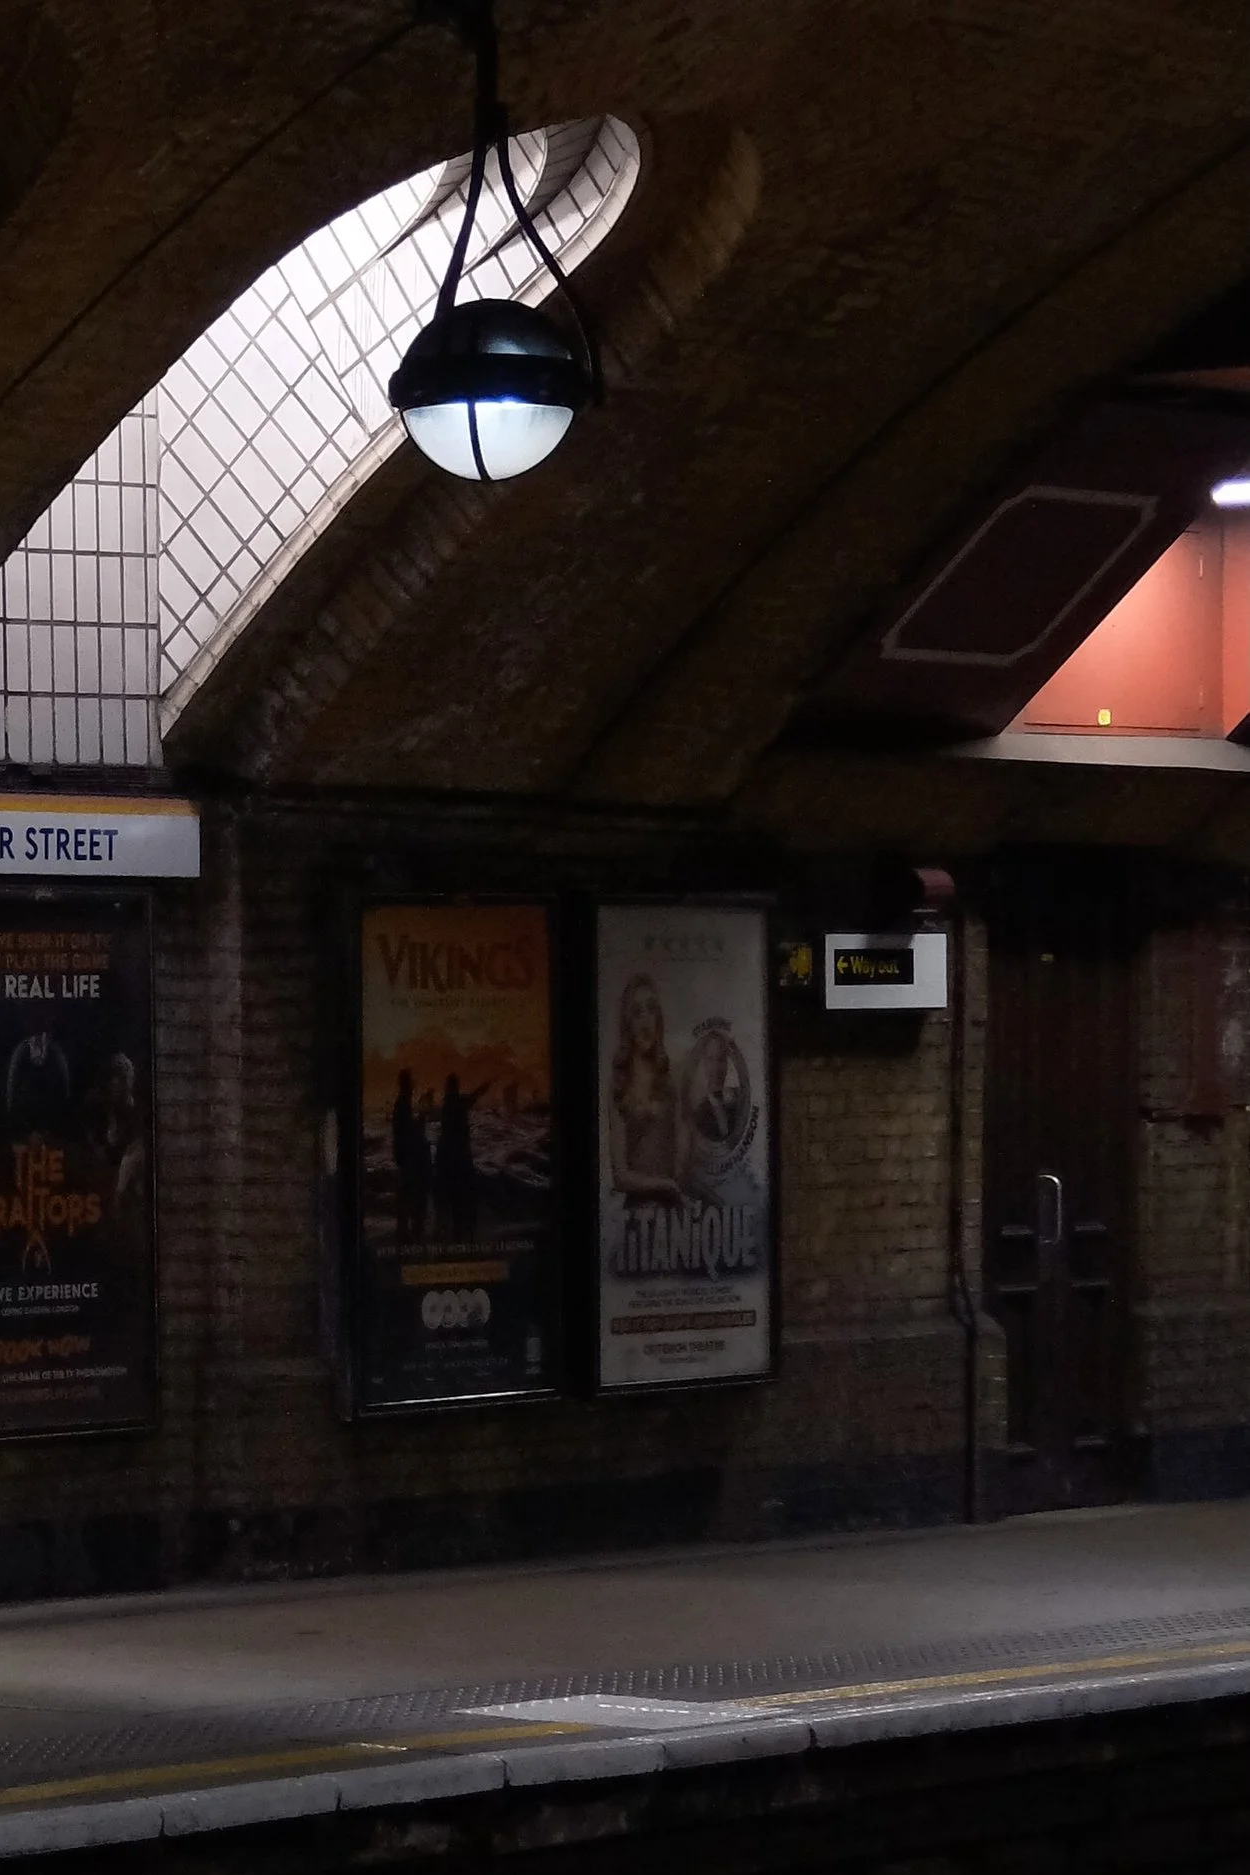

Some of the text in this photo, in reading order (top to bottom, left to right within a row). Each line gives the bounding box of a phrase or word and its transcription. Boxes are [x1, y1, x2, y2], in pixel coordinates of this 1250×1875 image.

[25, 827, 119, 861] STREET
[376, 934, 536, 993] VIKINGS
[850, 955, 900, 978] Way out
[4, 974, 55, 999] REAL
[61, 974, 101, 999] LIFE
[12, 1144, 65, 1188] THE
[17, 1282, 100, 1301] EXPERIENCE
